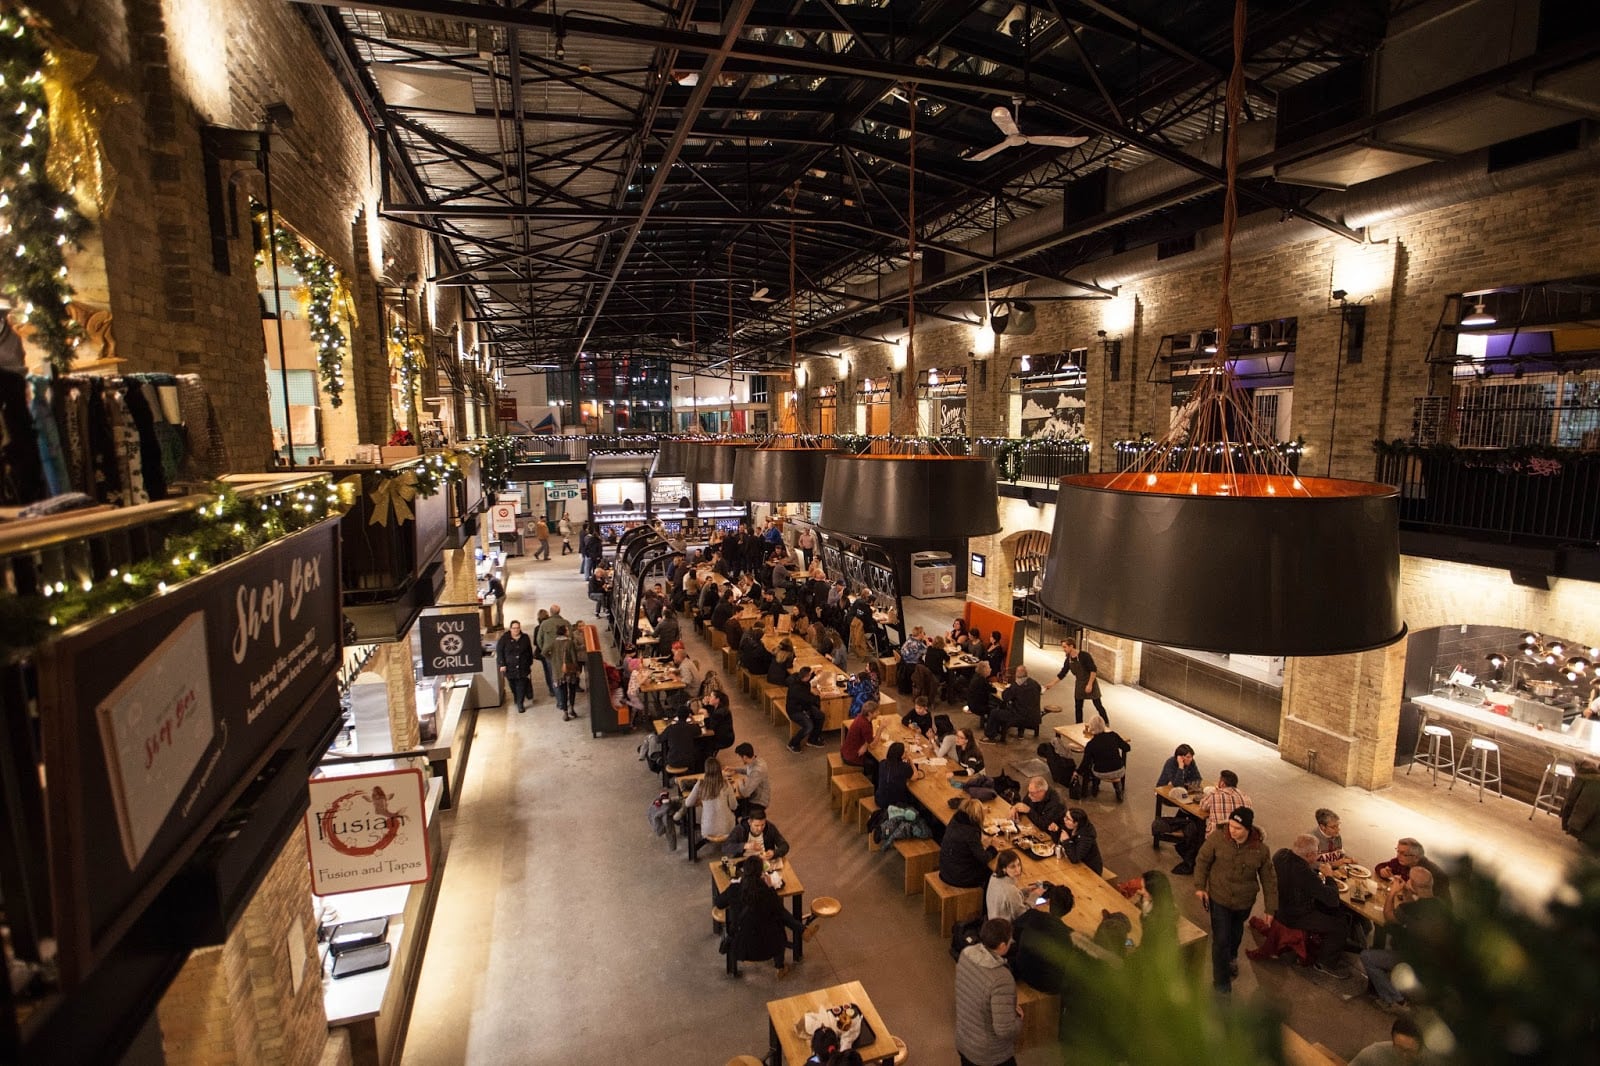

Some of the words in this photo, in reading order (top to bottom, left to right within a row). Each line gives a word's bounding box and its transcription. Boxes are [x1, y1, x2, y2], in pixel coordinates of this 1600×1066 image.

[233, 579, 284, 664] Shop
[290, 553, 321, 620] Box
[436, 621, 464, 633] KYU
[432, 655, 474, 669] GRILL
[319, 867, 359, 882] Fusion
[361, 862, 383, 875] and
[385, 859, 422, 875] Tapas
